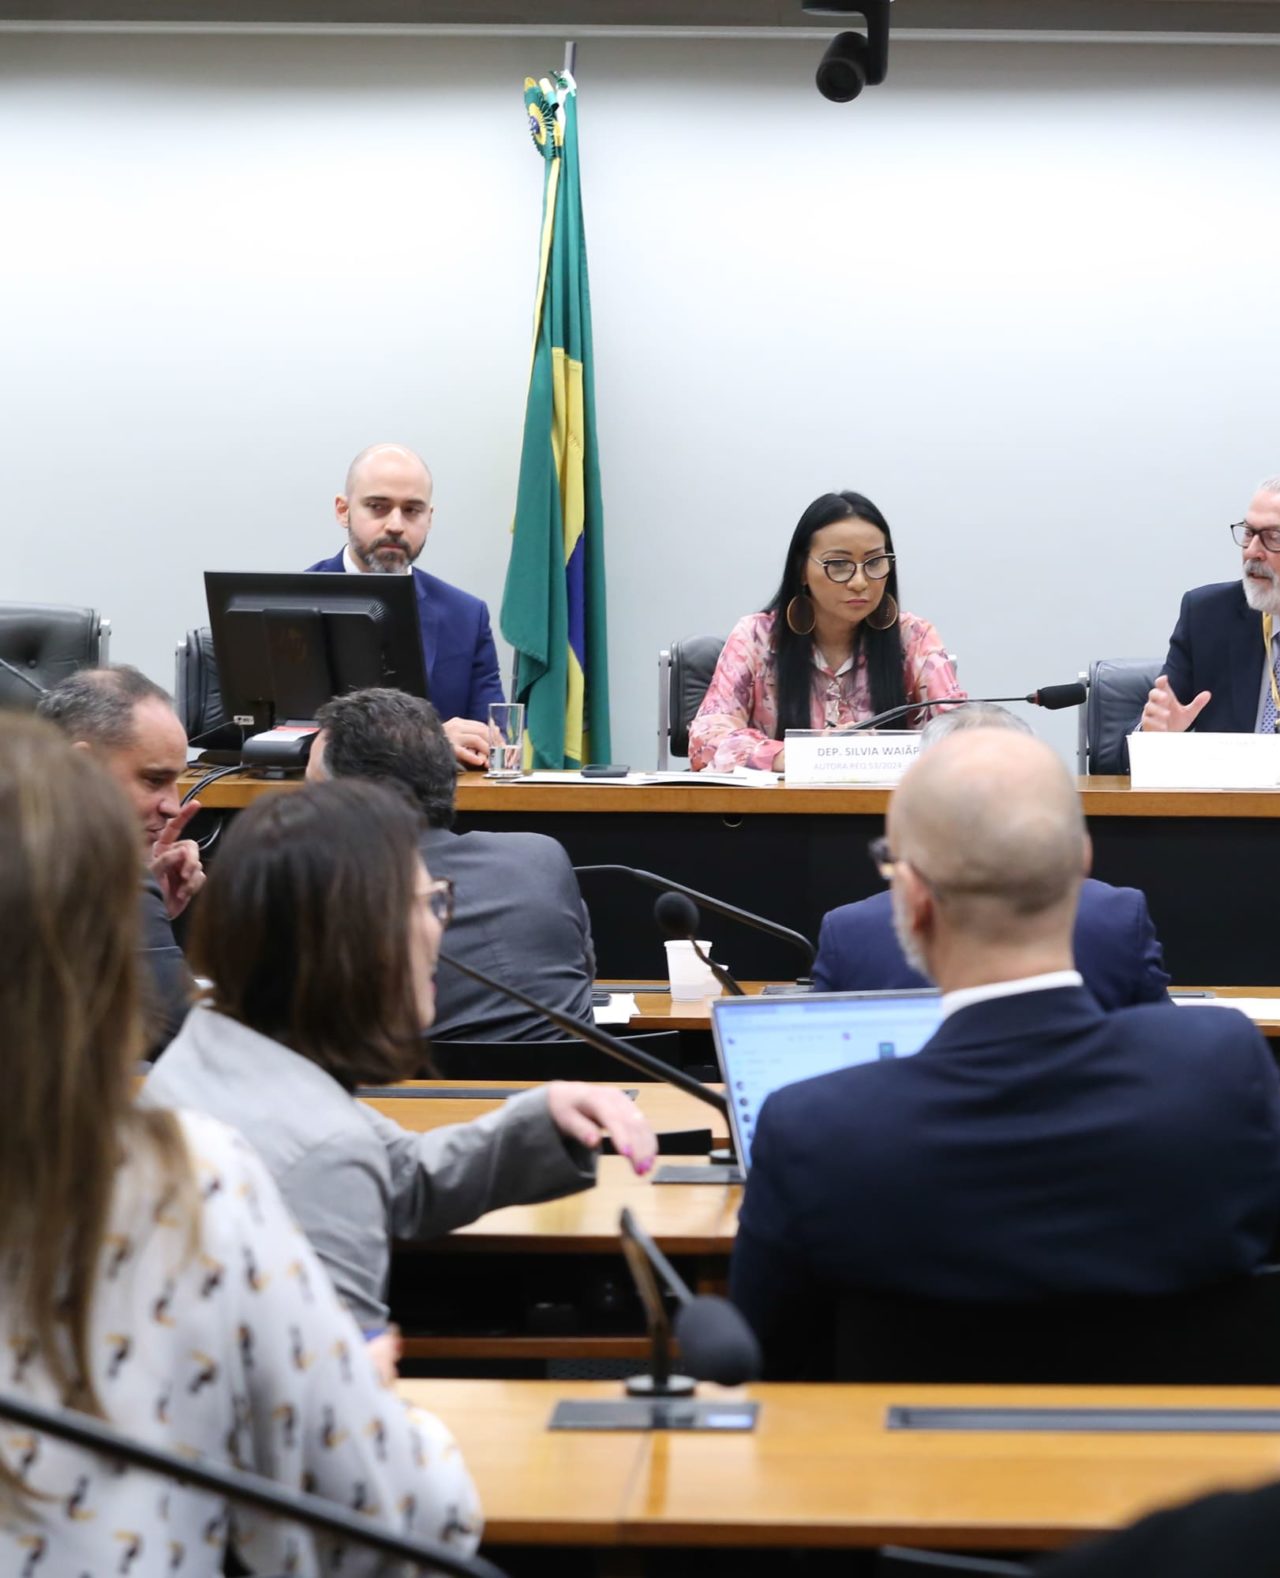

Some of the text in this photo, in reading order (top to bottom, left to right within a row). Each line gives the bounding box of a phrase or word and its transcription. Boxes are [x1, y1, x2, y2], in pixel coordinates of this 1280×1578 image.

[817, 744, 920, 757] DEP. SILVIA WAIÃP
